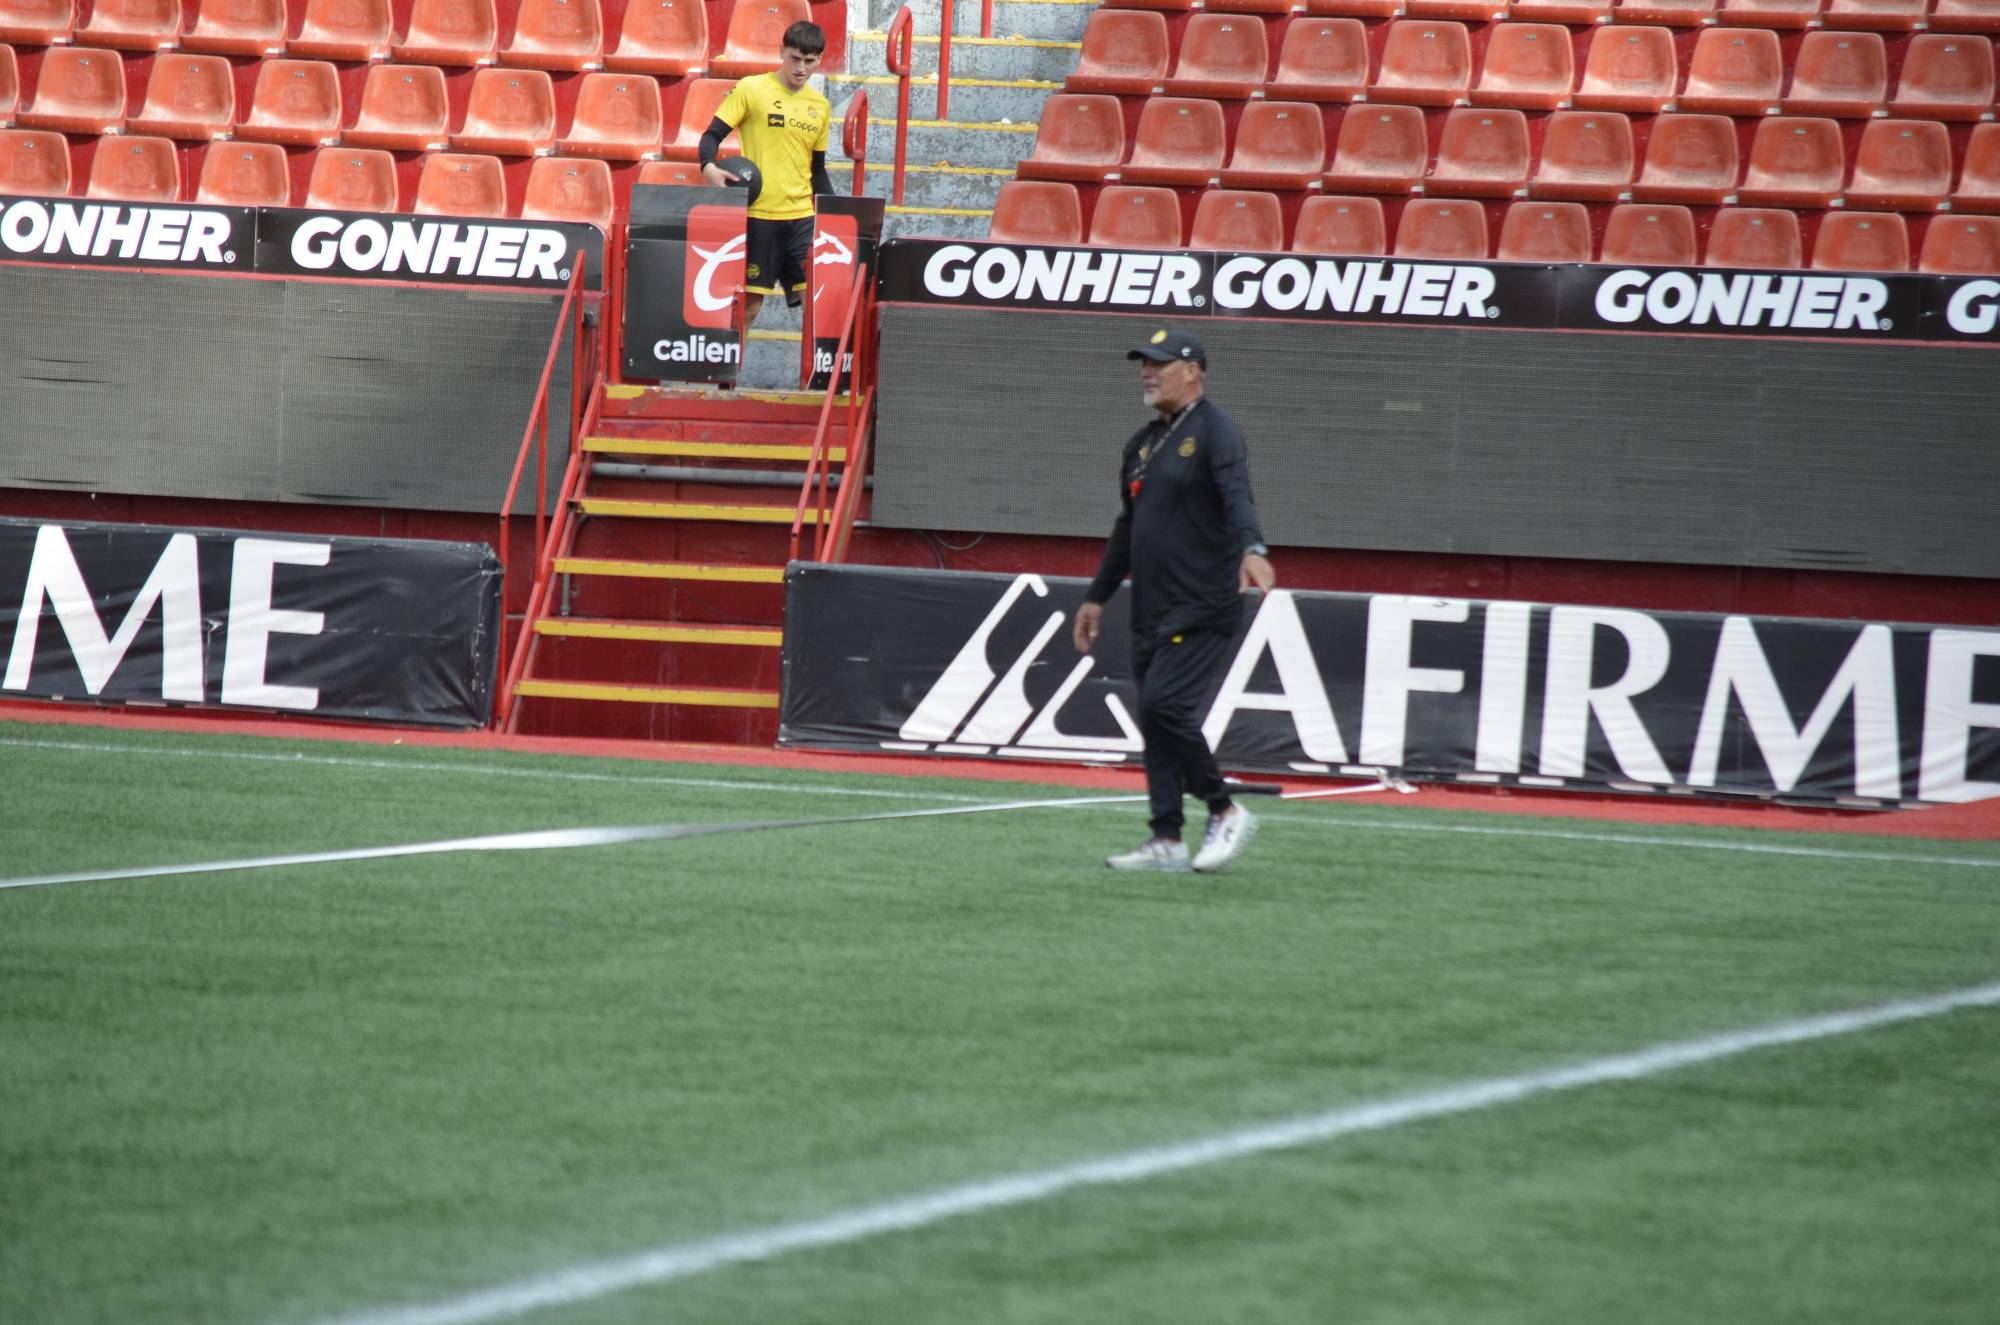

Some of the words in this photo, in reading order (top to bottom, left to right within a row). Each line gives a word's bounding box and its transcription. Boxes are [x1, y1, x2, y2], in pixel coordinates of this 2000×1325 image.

[654, 334, 740, 363] calien
[2, 525, 331, 710] ME
[1201, 588, 2000, 803] AFIRME
